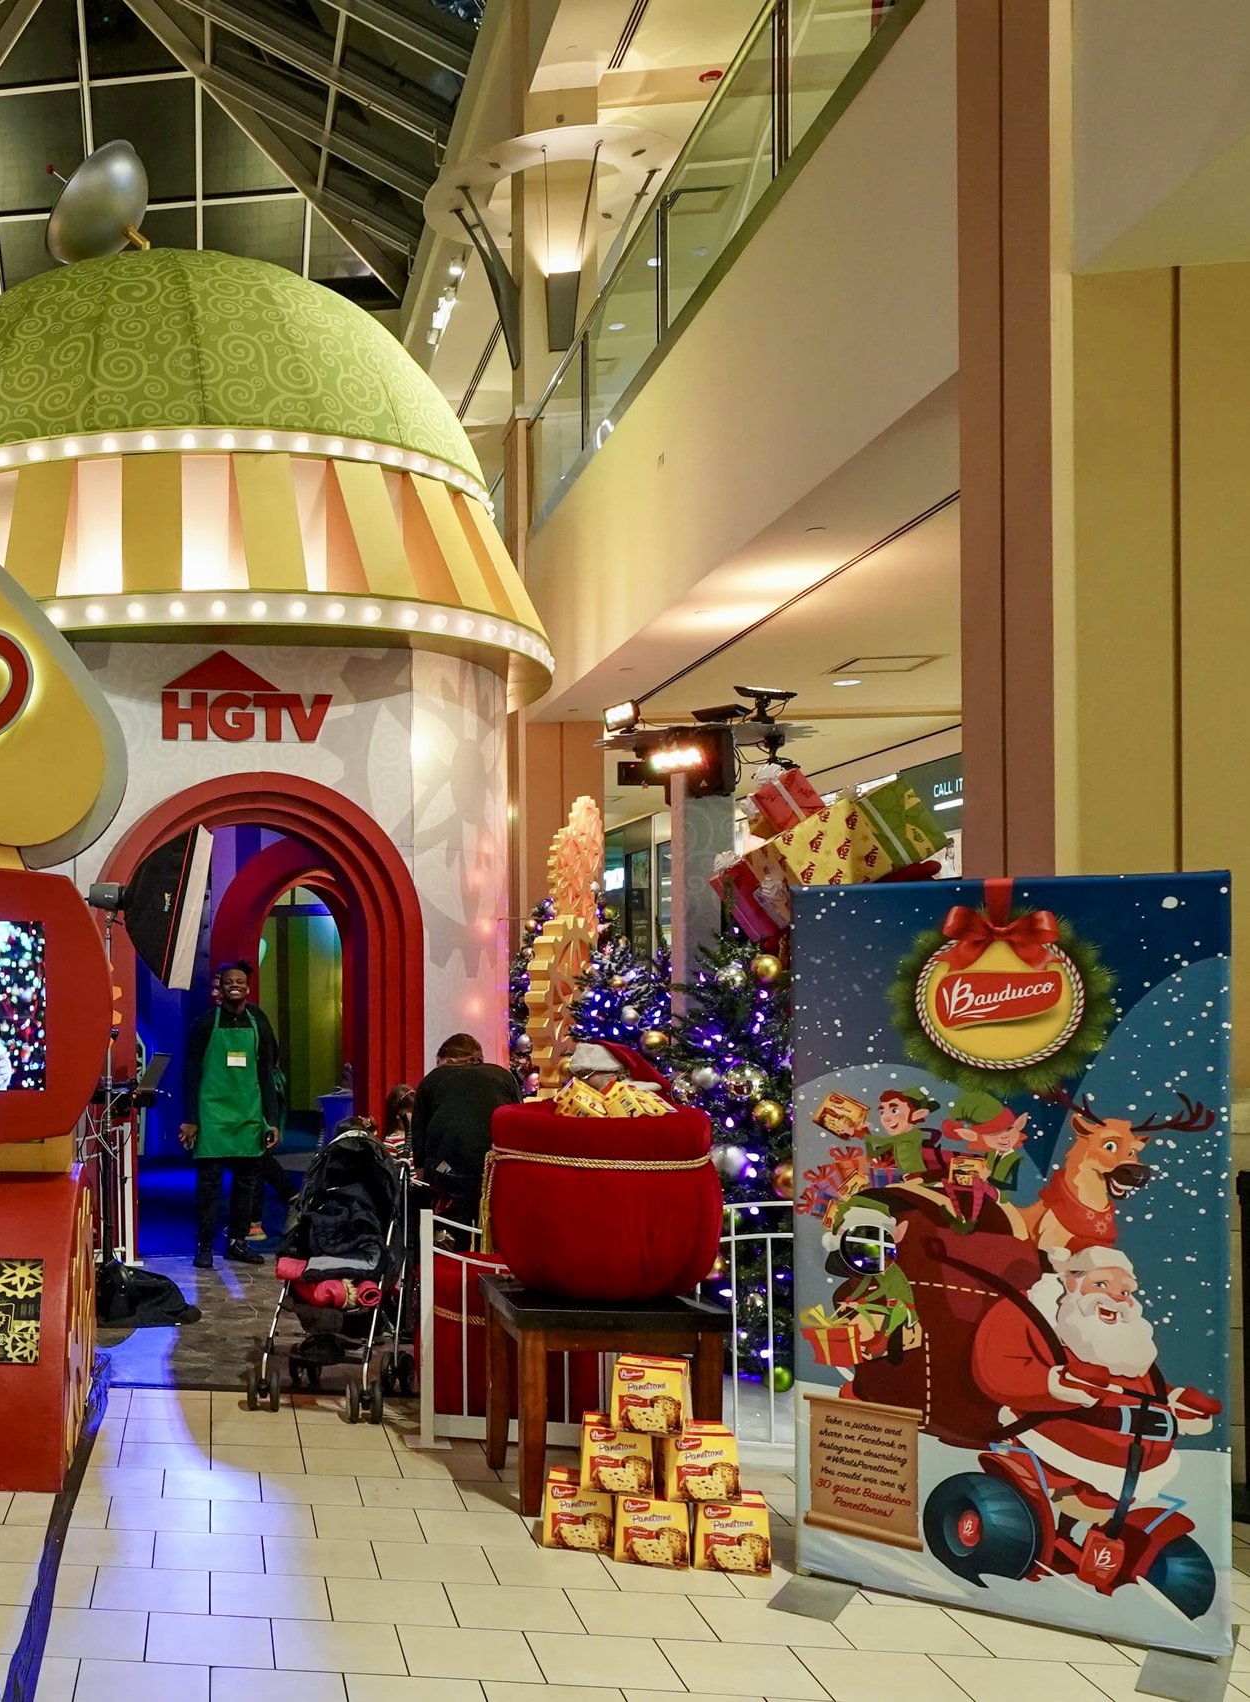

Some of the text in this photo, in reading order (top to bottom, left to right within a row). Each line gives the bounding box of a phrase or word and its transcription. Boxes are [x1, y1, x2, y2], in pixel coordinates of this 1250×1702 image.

[162, 691, 333, 744] HGTV
[933, 781, 953, 797] CALL
[941, 977, 1054, 1020] Bauducco
[627, 1381, 667, 1392] Panettone
[824, 1415, 842, 1426] Take
[851, 1421, 882, 1433] picture
[884, 1428, 902, 1437] and
[598, 1442, 638, 1453] Panettone
[818, 1428, 843, 1439] share
[857, 1433, 896, 1449] Facebook
[684, 1450, 725, 1461] Panettone
[818, 1440, 908, 1468] Instagram describing
[820, 1465, 907, 1494] You could win one of
[815, 1477, 912, 1507] 30 giant Bauducco
[558, 1500, 599, 1511] Panettone
[833, 1496, 895, 1518] Panettones!
[631, 1513, 673, 1524] Panettone
[713, 1520, 754, 1531] Panettone
